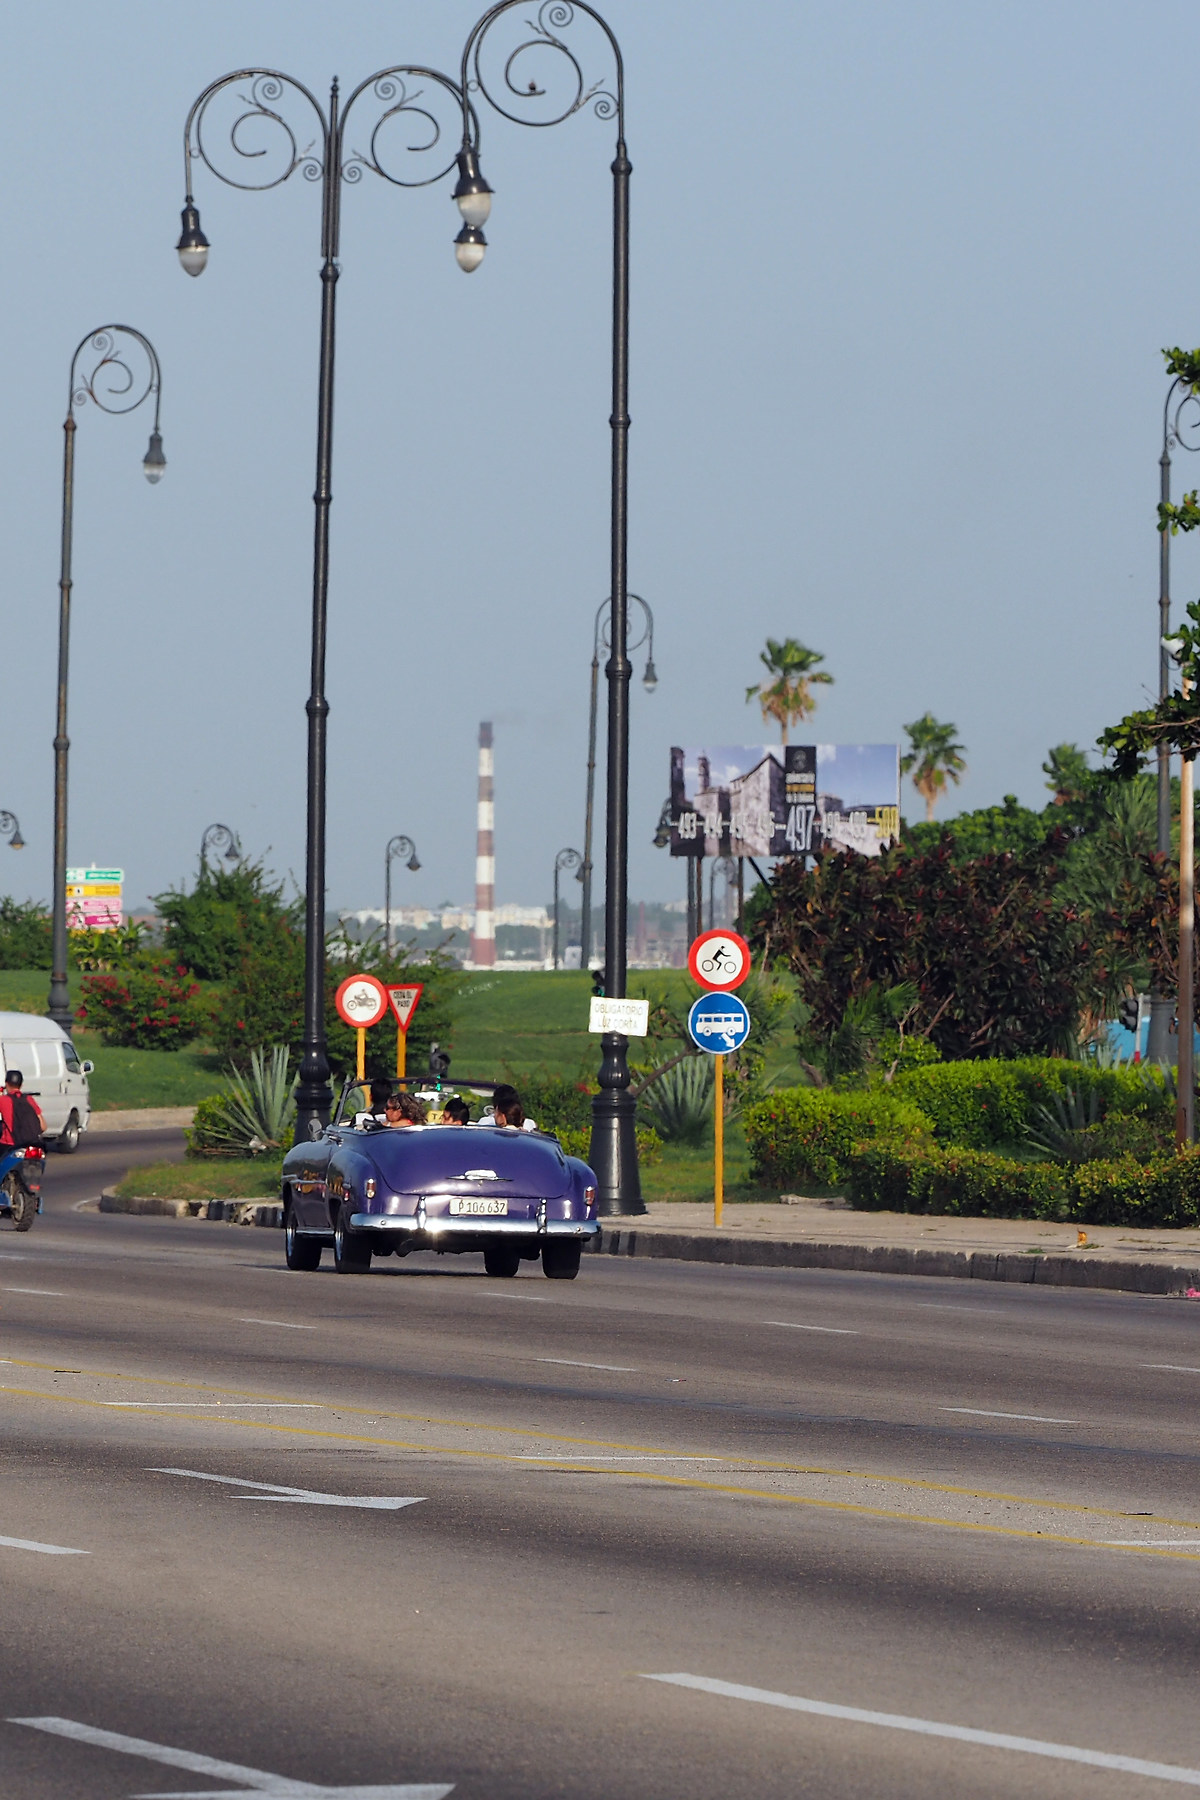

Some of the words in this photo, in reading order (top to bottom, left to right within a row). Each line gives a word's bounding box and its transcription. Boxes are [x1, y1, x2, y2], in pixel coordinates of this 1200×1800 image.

[785, 804, 816, 851] 497
[594, 1003, 643, 1016] OBLIGATORIO
[598, 1016, 611, 1028] LUZ
[614, 1018, 638, 1028] CORTA
